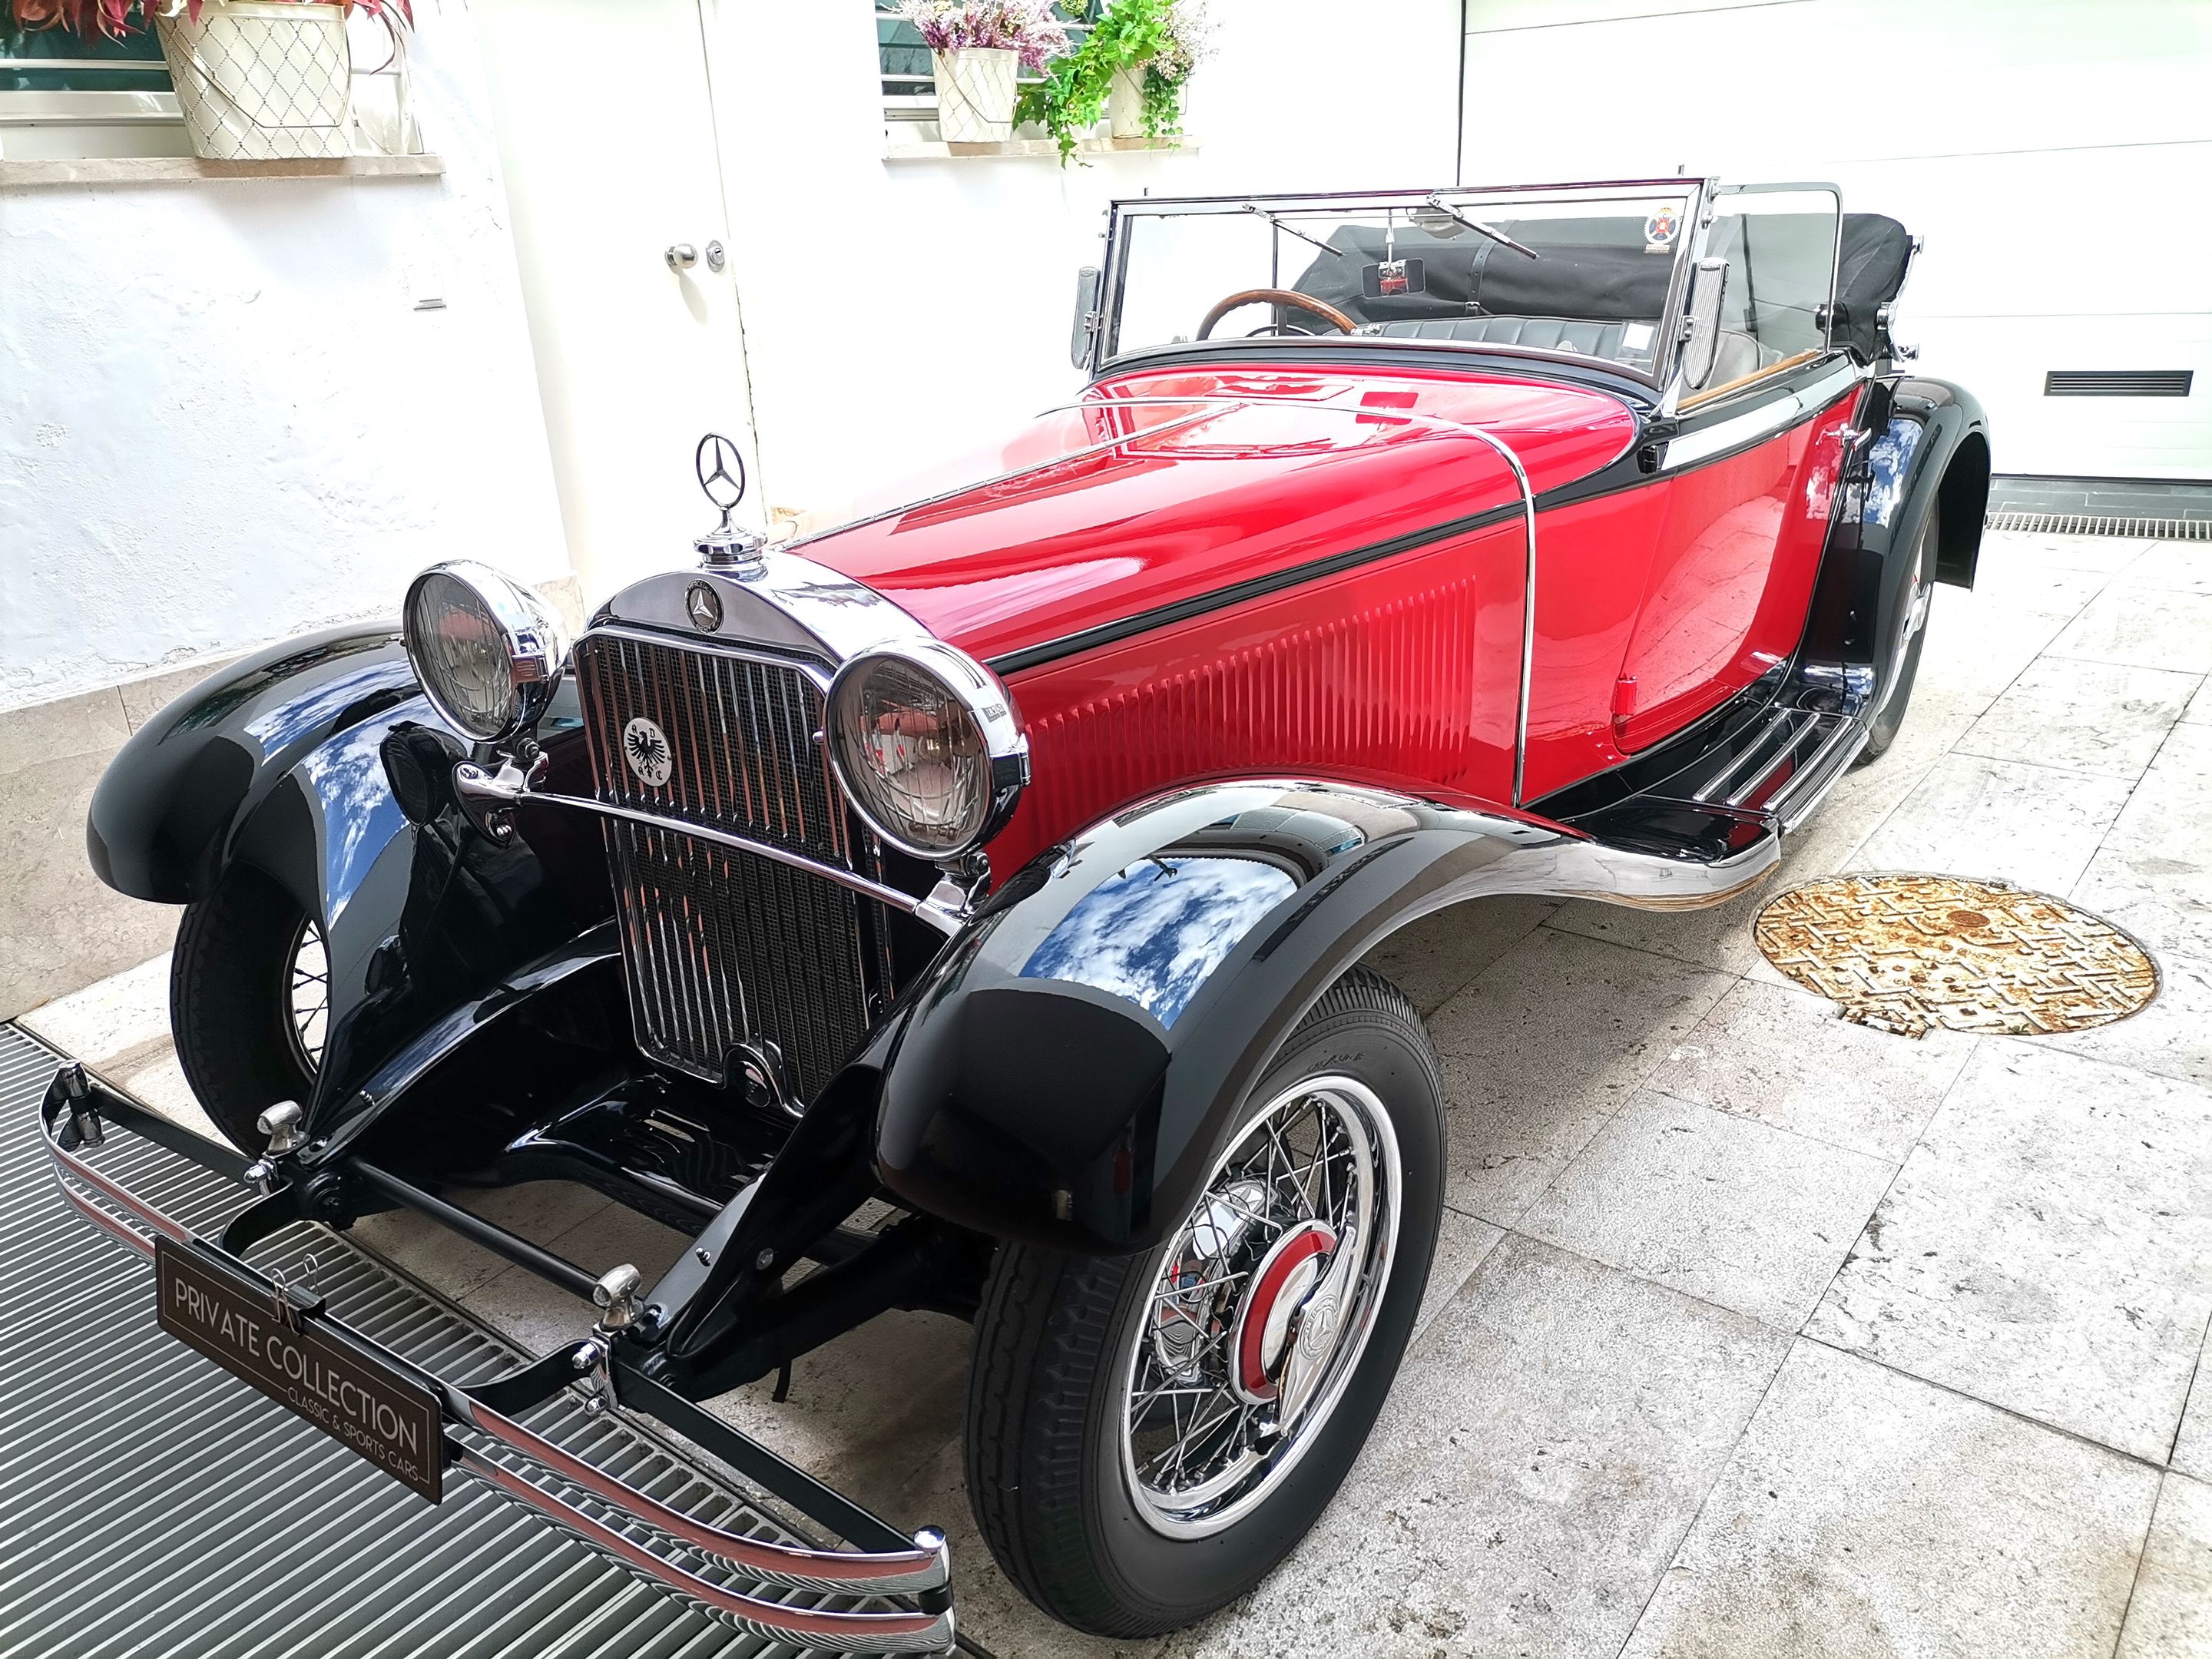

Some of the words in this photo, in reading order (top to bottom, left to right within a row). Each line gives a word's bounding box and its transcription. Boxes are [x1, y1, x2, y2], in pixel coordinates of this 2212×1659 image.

[175, 1277, 260, 1357] PRIVATE
[267, 1336, 417, 1456] COLLECTION
[287, 1386, 329, 1424] CLASSIC
[332, 1415, 341, 1432] &
[343, 1421, 386, 1460] SPORTS
[388, 1450, 419, 1482] CARS
